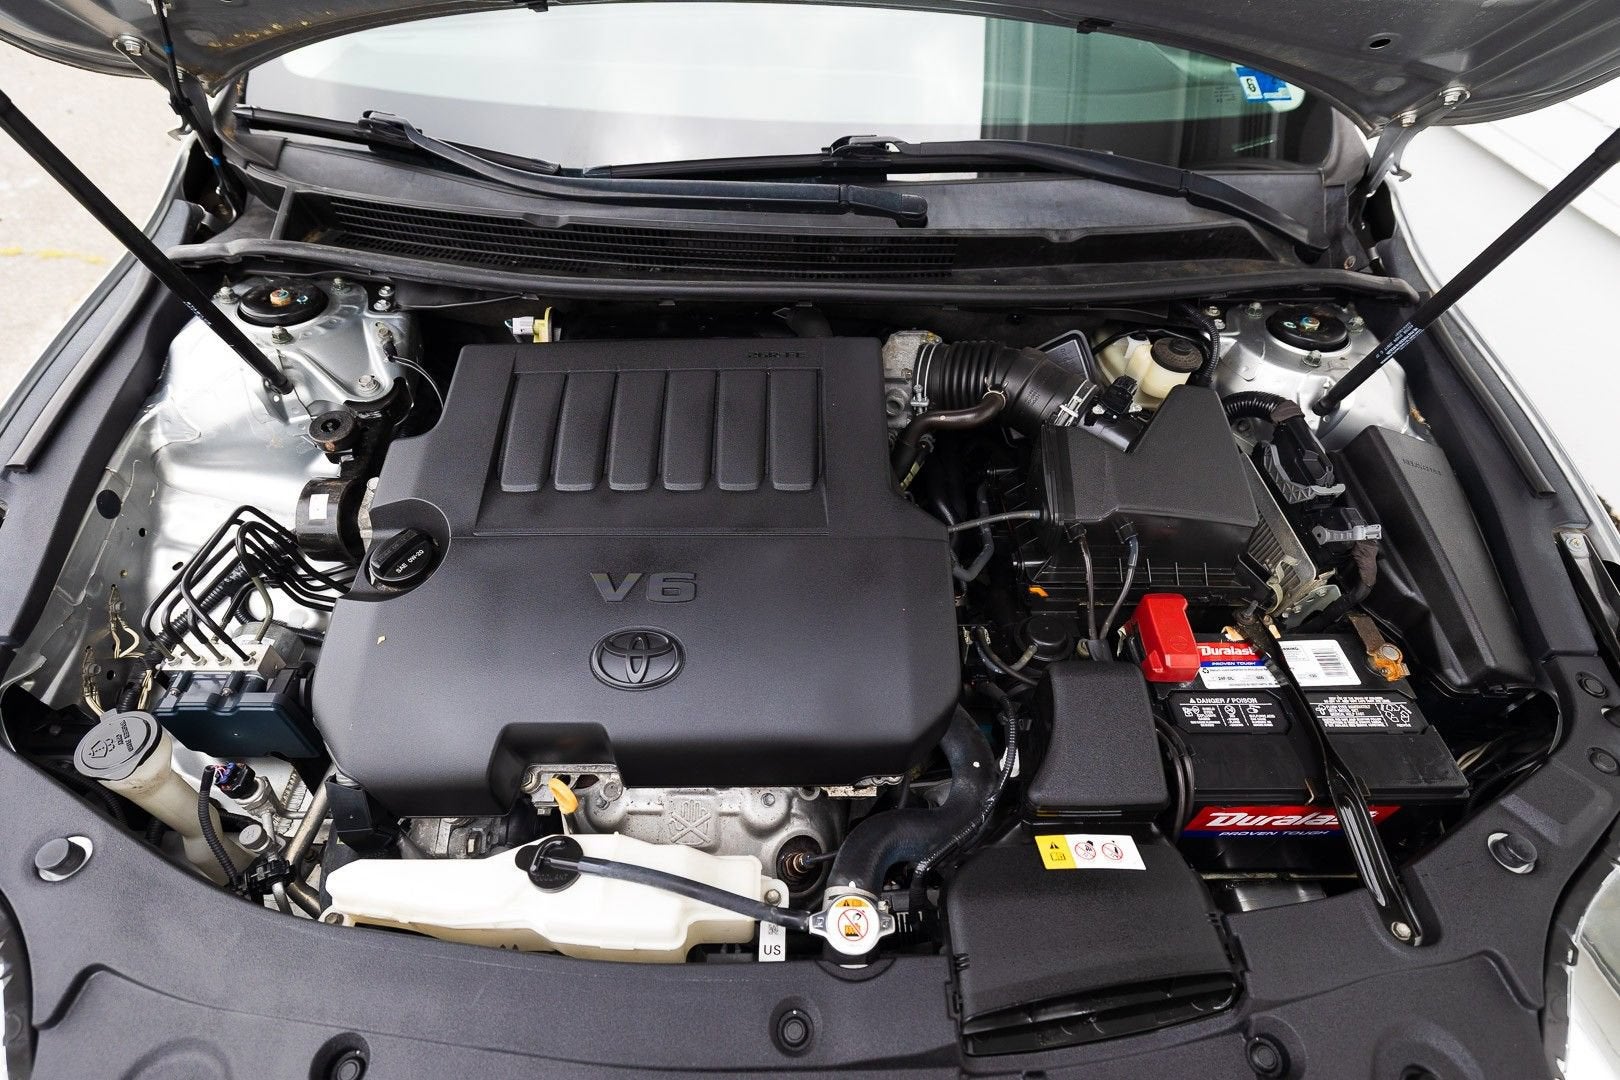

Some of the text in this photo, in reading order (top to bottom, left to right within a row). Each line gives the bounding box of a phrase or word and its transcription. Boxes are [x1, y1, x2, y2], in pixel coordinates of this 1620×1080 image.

[589, 571, 698, 604] V6
[1197, 645, 1256, 656] Duralast
[1206, 811, 1379, 827] Durala
[763, 944, 781, 956] US
